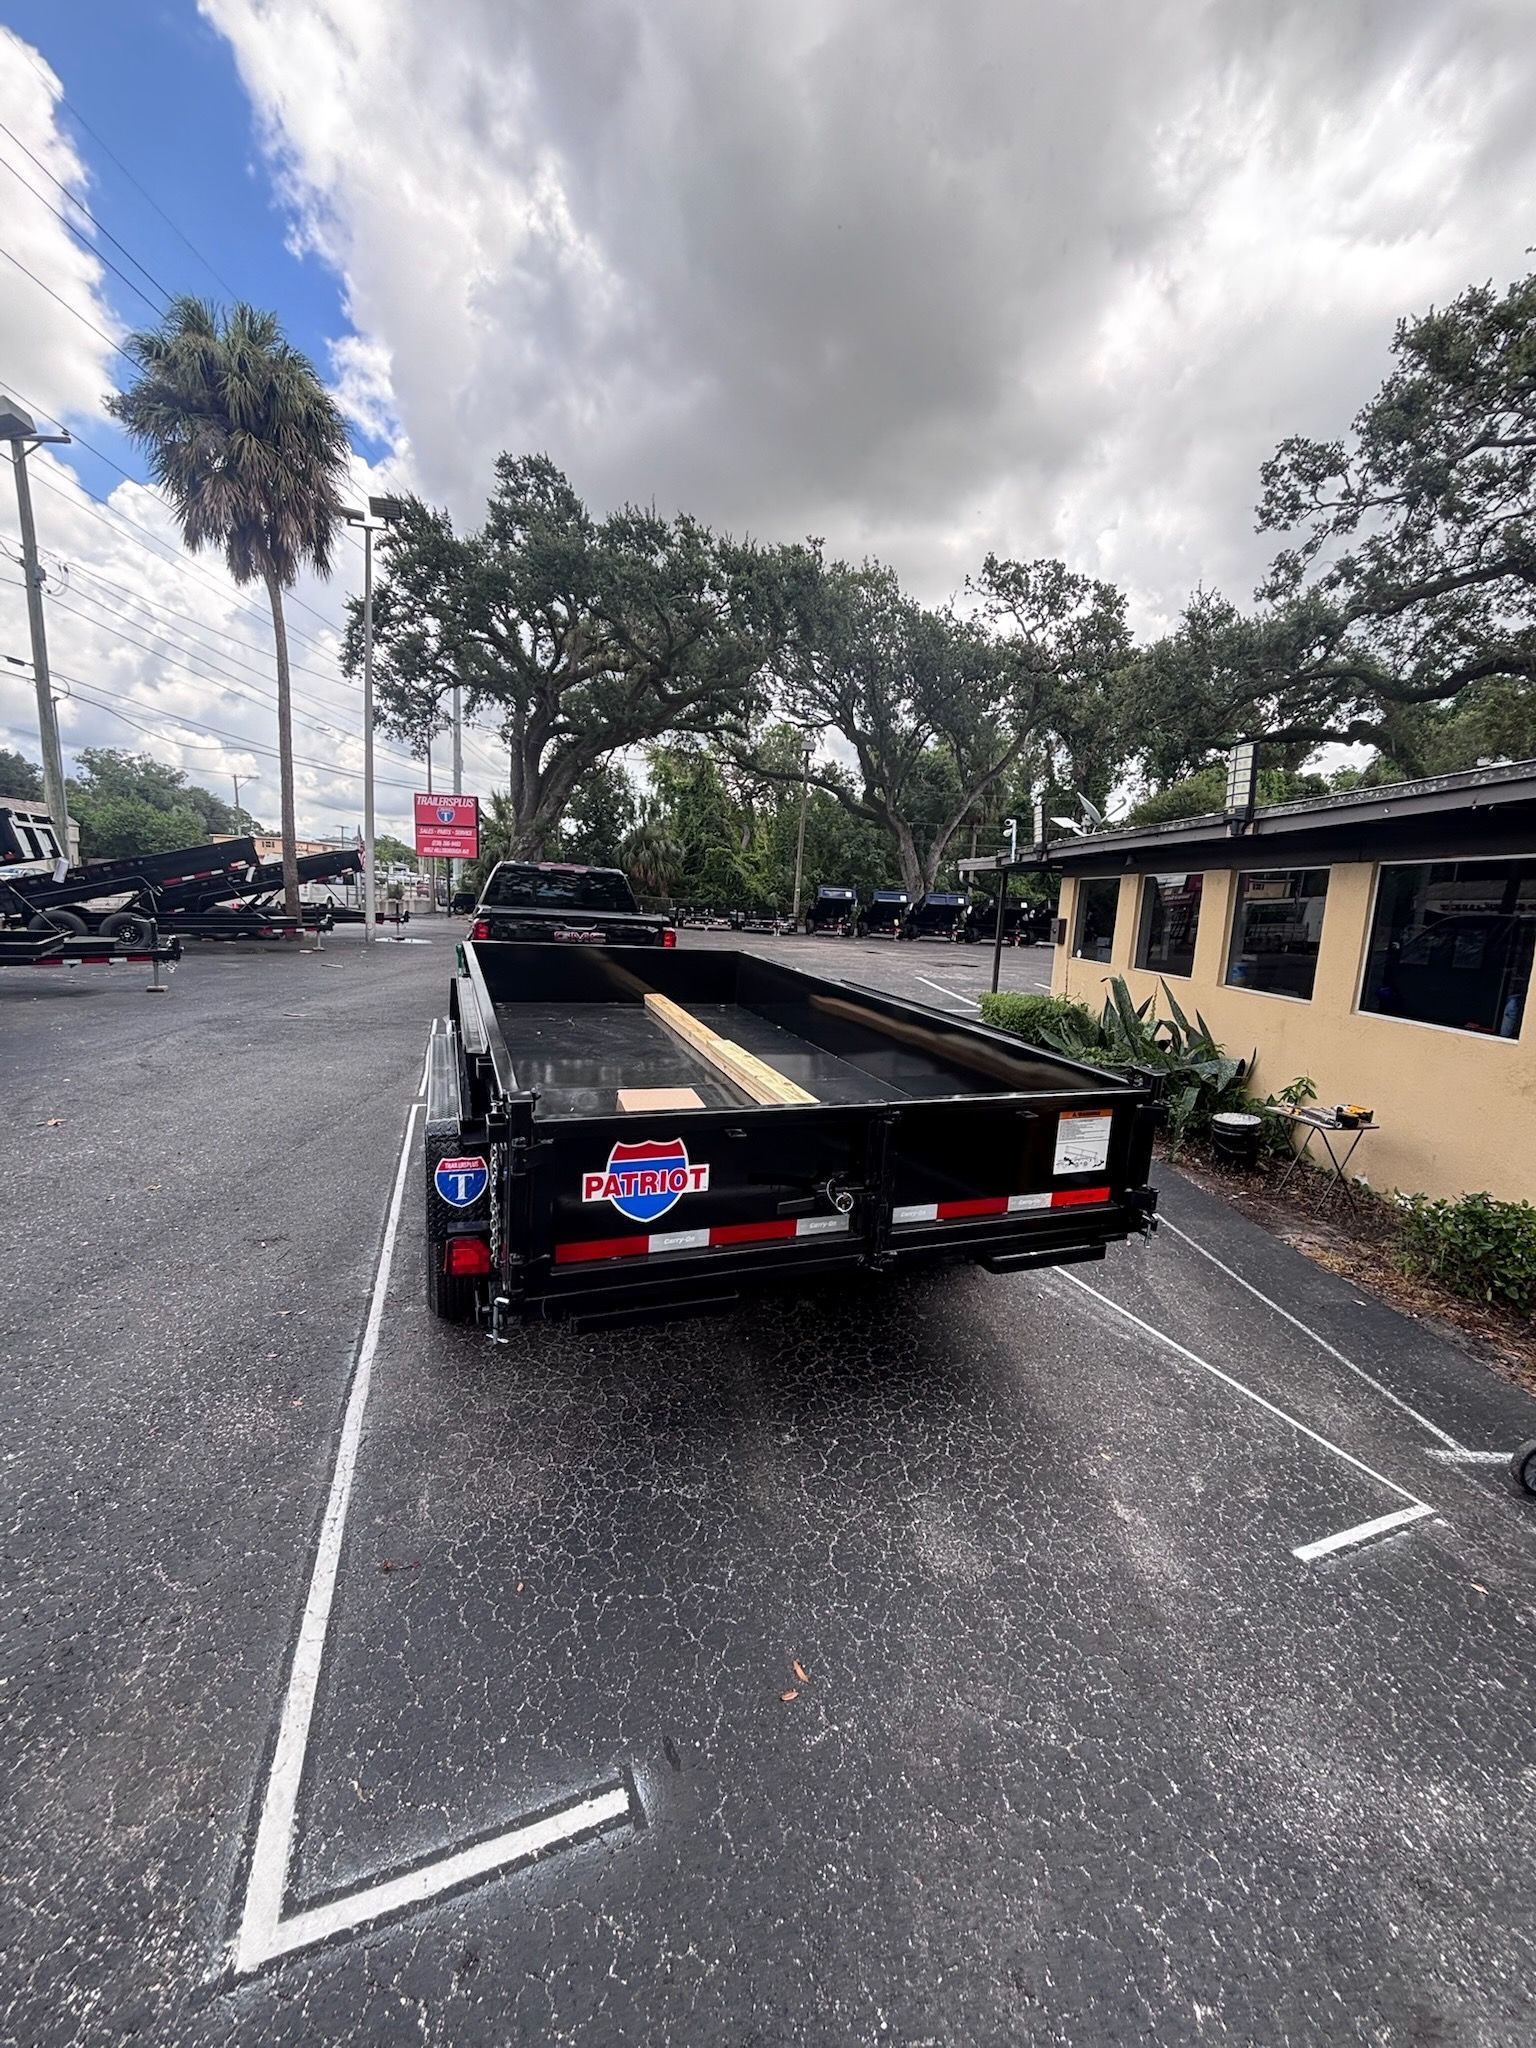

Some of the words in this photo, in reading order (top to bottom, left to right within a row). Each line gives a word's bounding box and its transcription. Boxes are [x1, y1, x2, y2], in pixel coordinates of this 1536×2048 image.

[416, 796, 475, 808] TRAILERSPLUS
[553, 931, 606, 943] GMC
[444, 1160, 480, 1169] TRAILERSPLUS
[448, 1173, 475, 1200] T
[585, 1167, 707, 1199] PATRIOT
[809, 1220, 837, 1229] Carry-On
[663, 1235, 696, 1245] Carry-On
